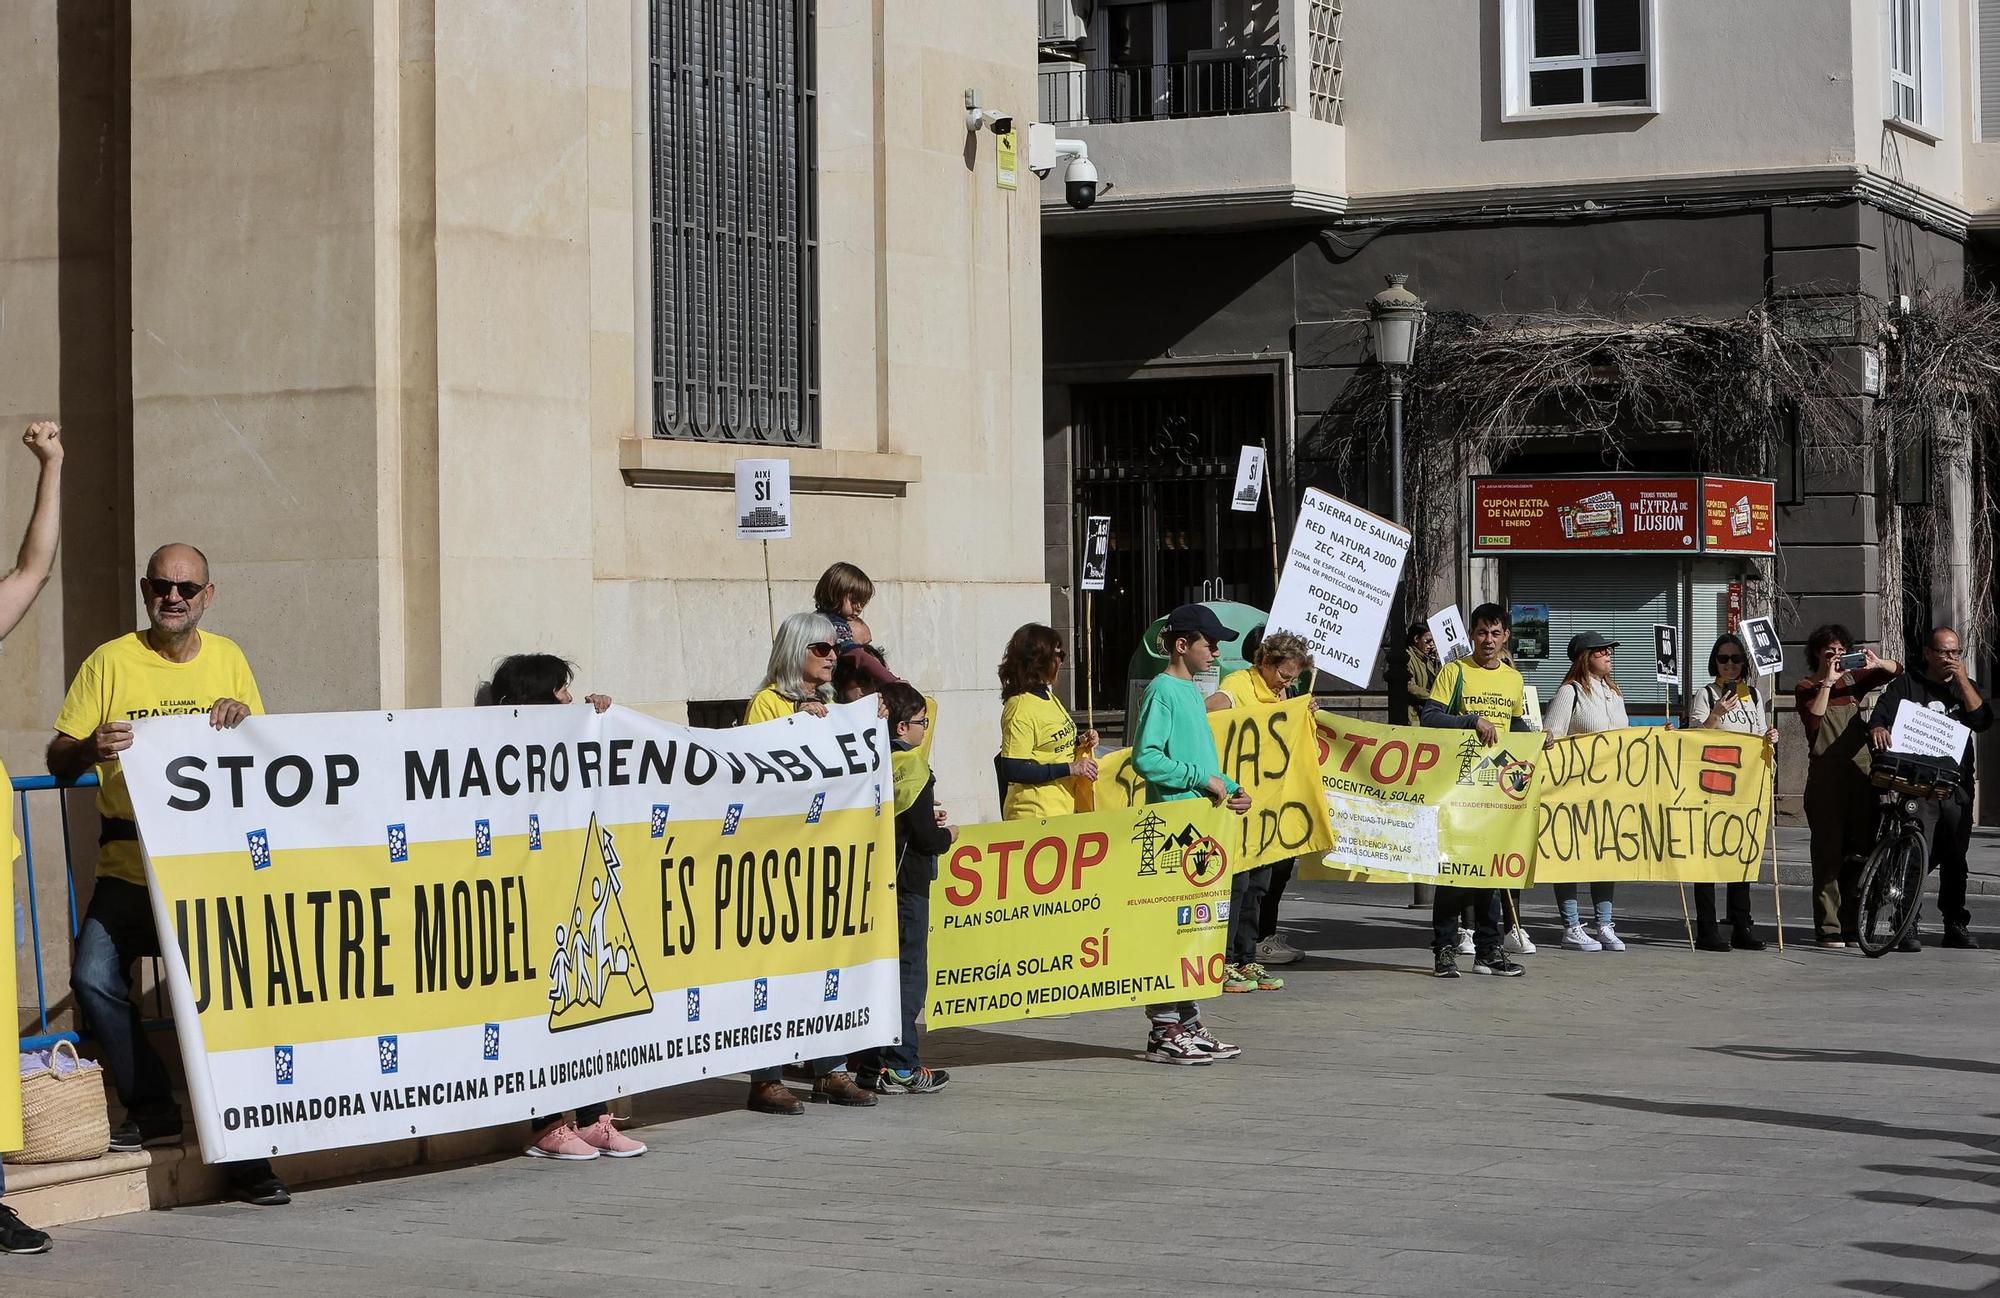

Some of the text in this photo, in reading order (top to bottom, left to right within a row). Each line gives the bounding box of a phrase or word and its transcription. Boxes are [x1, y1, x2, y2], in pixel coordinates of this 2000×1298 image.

[754, 469, 771, 479] AIXÍ
[754, 479, 771, 501] SÍ
[1482, 498, 1550, 508] CUPÓN EXTRA
[1488, 509, 1544, 518] DE NAVIDAD
[1630, 499, 1688, 515] UN EXTRA DE
[1303, 494, 1410, 551] LA SIERRA DE SALINAS
[1634, 514, 1684, 532] ILUSIÓN
[1305, 518, 1397, 568] RED NATURA 2000
[1314, 540, 1367, 572] ZEC, ZEPA,
[1294, 560, 1310, 572] ZONA
[1312, 568, 1320, 576] DE
[1320, 572, 1355, 593] PROTECCIÓN
[1357, 589, 1366, 597] DE
[1313, 558, 1321, 566] DE
[1321, 561, 1346, 578] ESPECIAL
[1347, 574, 1391, 598] CONSERVACIÓN
[1308, 584, 1358, 614] RODEADO
[1318, 603, 1340, 620] POR
[1305, 612, 1343, 635] 16 KM2
[1313, 629, 1328, 641] DE
[1444, 626, 1457, 642] SÍ
[1662, 640, 1672, 656] NO
[1756, 632, 1770, 648] NO
[1903, 724, 1946, 746] MACROPLANTAS
[1903, 734, 1925, 746] SALVAD
[1317, 723, 1441, 786] STOP
[1542, 727, 1682, 790] UACIÓN
[165, 754, 360, 812] STOP
[1321, 775, 1425, 804] ROCENTRAL SOLAR
[1349, 813, 1376, 824] VENDAS
[1376, 817, 1386, 826] TU
[1349, 837, 1358, 846] DE
[1358, 849, 1389, 860] SOLARES
[944, 831, 1109, 907] STOP
[1438, 852, 1526, 878] IENTAL NO
[660, 837, 877, 957] ÉS POSSIBLE
[944, 894, 1101, 929] PLAN SOLAR VINALOPÓ
[176, 876, 537, 1014] UN ALTRE MODEL
[935, 928, 1111, 986] ENERGÍA SOLAR SÍ
[932, 952, 1226, 1017] ATENTADO MEDIOAMBIENTAL NO
[222, 1006, 870, 1131] ORDINADORA VALENCIANA PER LA UBICACIÓ RACIONAL DE LES ENERGIES RENOVABLES
